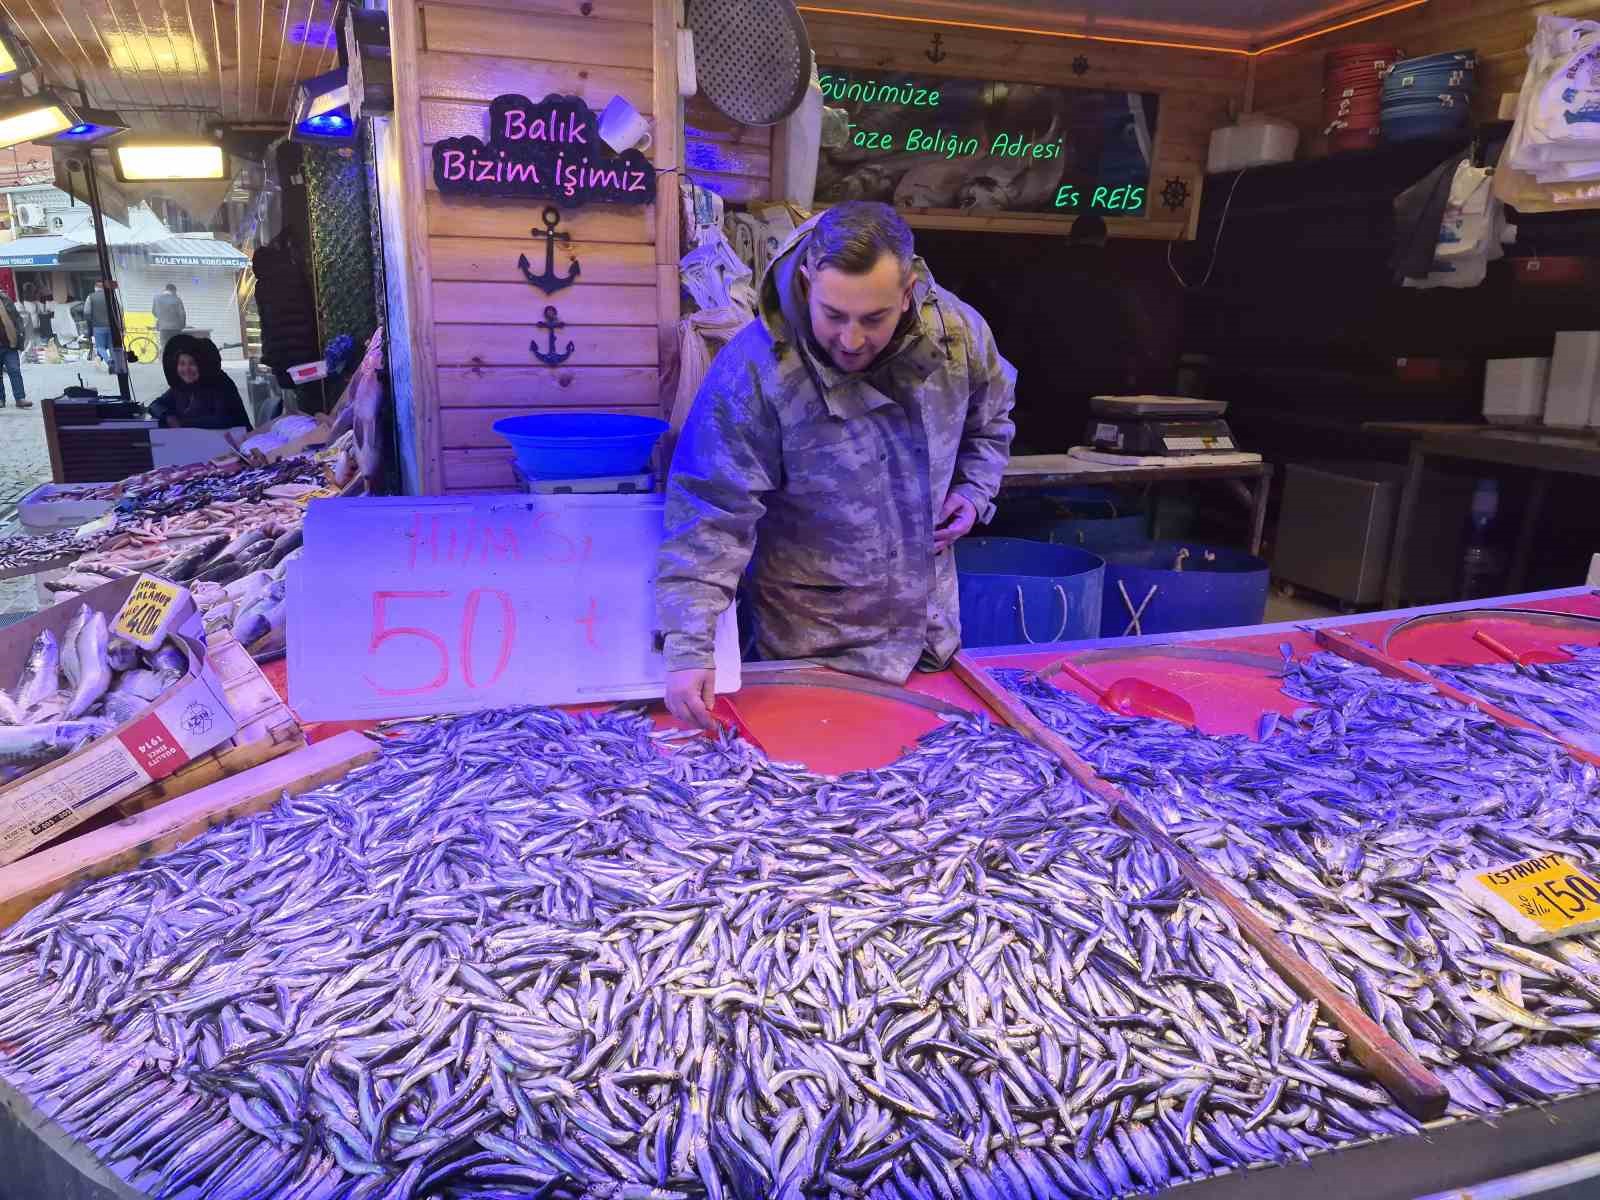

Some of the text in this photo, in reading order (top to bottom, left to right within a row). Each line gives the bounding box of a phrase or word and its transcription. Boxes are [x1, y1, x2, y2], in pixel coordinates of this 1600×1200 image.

[503, 109, 587, 144] Balık
[905, 128, 978, 160] Balığın
[990, 132, 1063, 160] Adresi
[442, 149, 647, 196] Bizim İşimiz
[1055, 186, 1079, 208] Es
[361, 587, 519, 697] 50
[138, 734, 164, 754] 1914
[1533, 874, 1600, 920] 150
